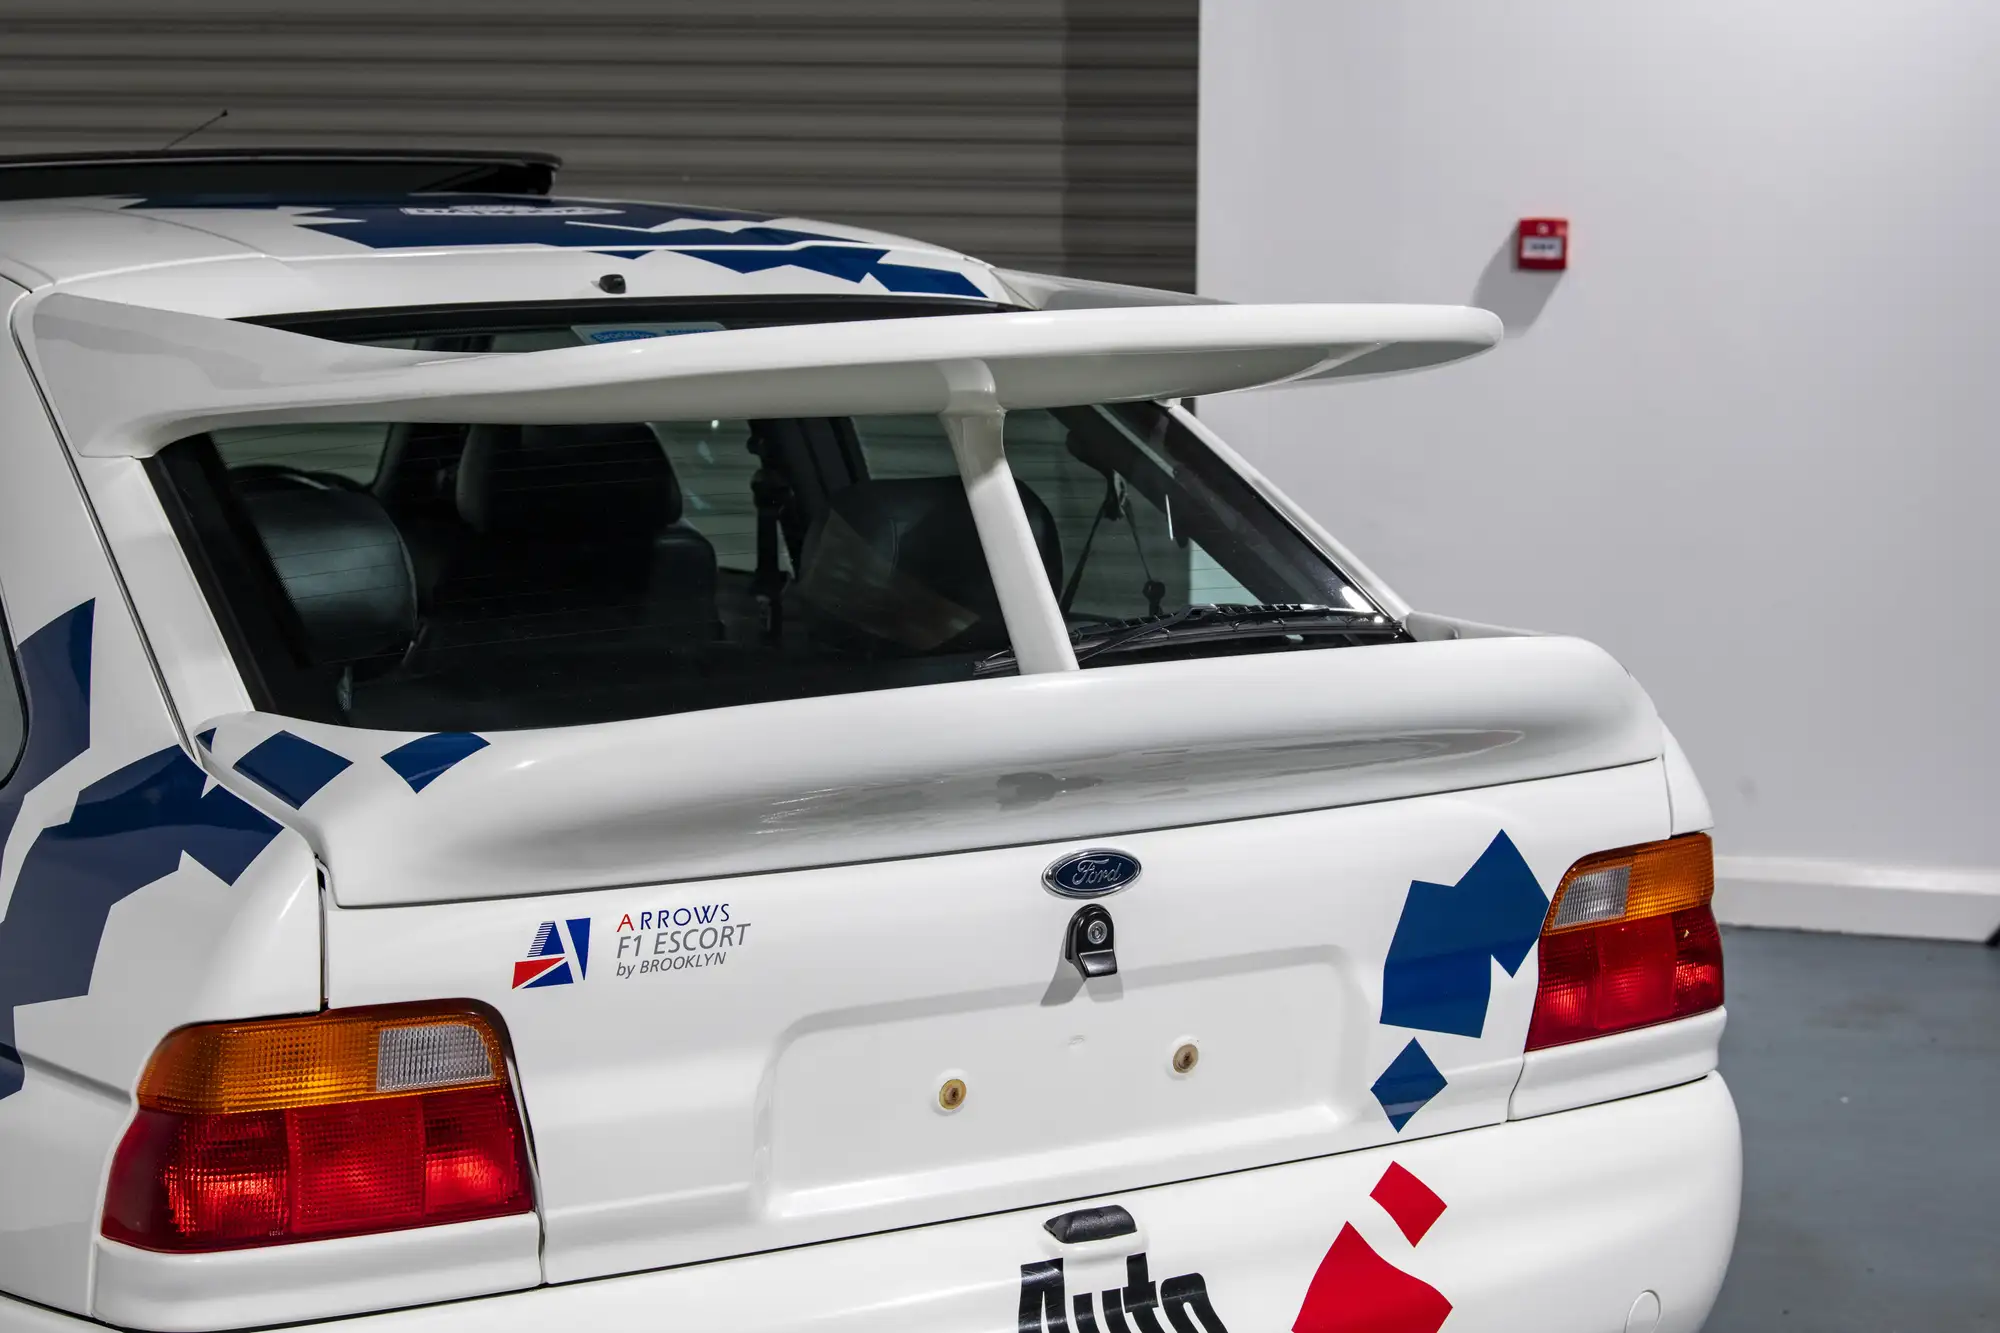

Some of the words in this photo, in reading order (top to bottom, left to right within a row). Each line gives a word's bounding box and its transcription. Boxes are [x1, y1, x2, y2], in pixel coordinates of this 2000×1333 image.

[1072, 858, 1122, 885] Ford
[616, 903, 730, 932] ARROWS
[616, 935, 642, 958] F1
[653, 923, 751, 955] ESCORT
[616, 962, 635, 979] by
[639, 951, 727, 974] BROOKLYN
